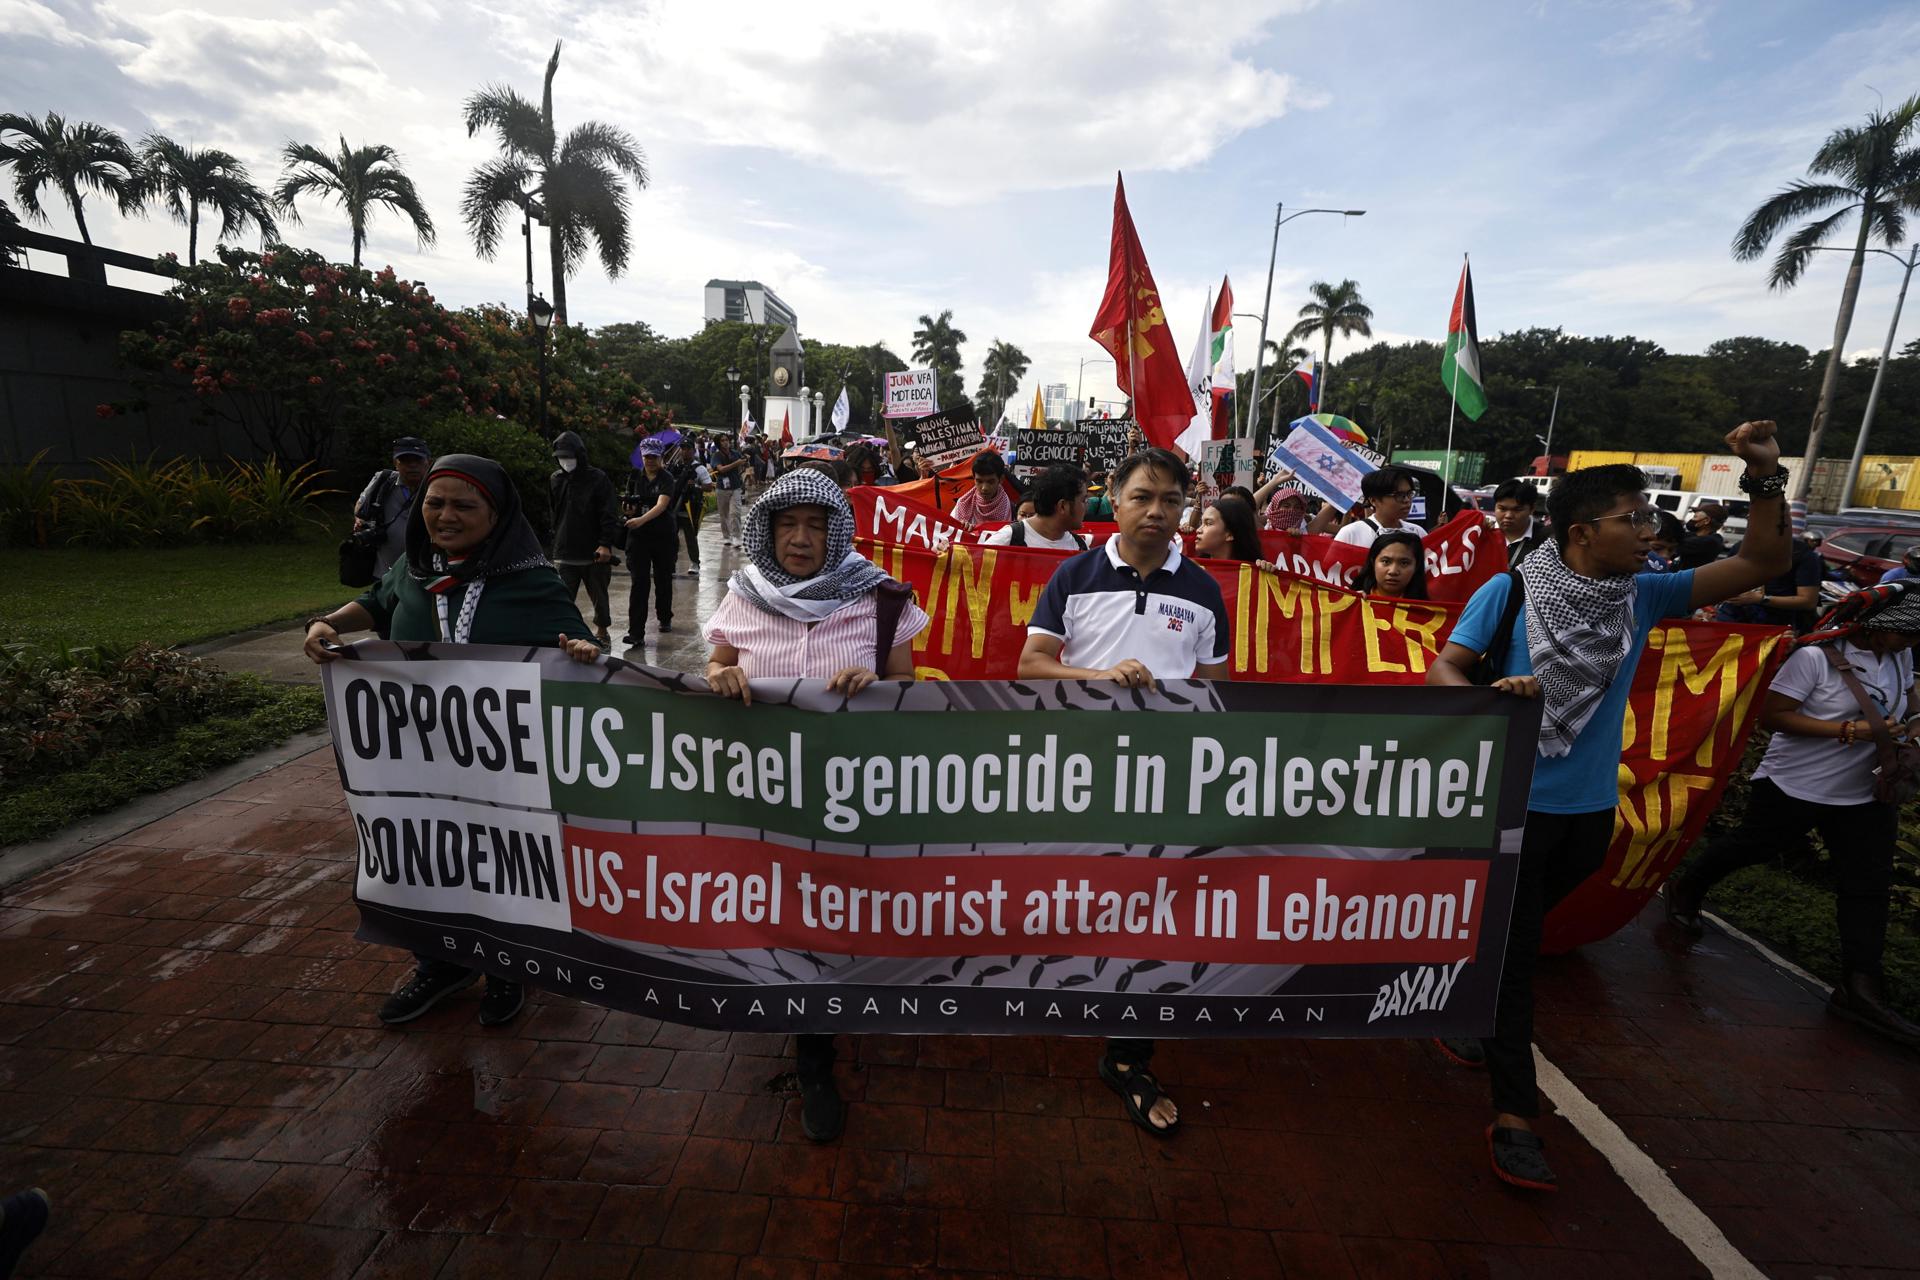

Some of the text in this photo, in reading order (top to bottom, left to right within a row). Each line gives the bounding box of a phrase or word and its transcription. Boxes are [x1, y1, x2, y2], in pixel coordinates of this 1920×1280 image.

[890, 372, 932, 387] JUNK VFA
[891, 387, 932, 402] MDT EDCA
[916, 417, 950, 433] SULONG
[921, 420, 977, 443] PALESTINA!
[1019, 430, 1035, 444] NO
[1037, 432, 1065, 445] MORE
[1017, 444, 1033, 460] FOR
[1034, 445, 1078, 461] GENOCIDE
[1208, 445, 1242, 458] FREE
[1158, 603, 1197, 624] MAKABAYAN
[344, 678, 1494, 833] OPPOSE US-Israel genocide in Palestine!
[356, 812, 1477, 942] CONDEMN US-Israel terrorist attack in Lebanon!
[443, 936, 1325, 1024] BAGONG ALYANSANG MAKABAYAN
[1367, 956, 1471, 1025] BAYAN
